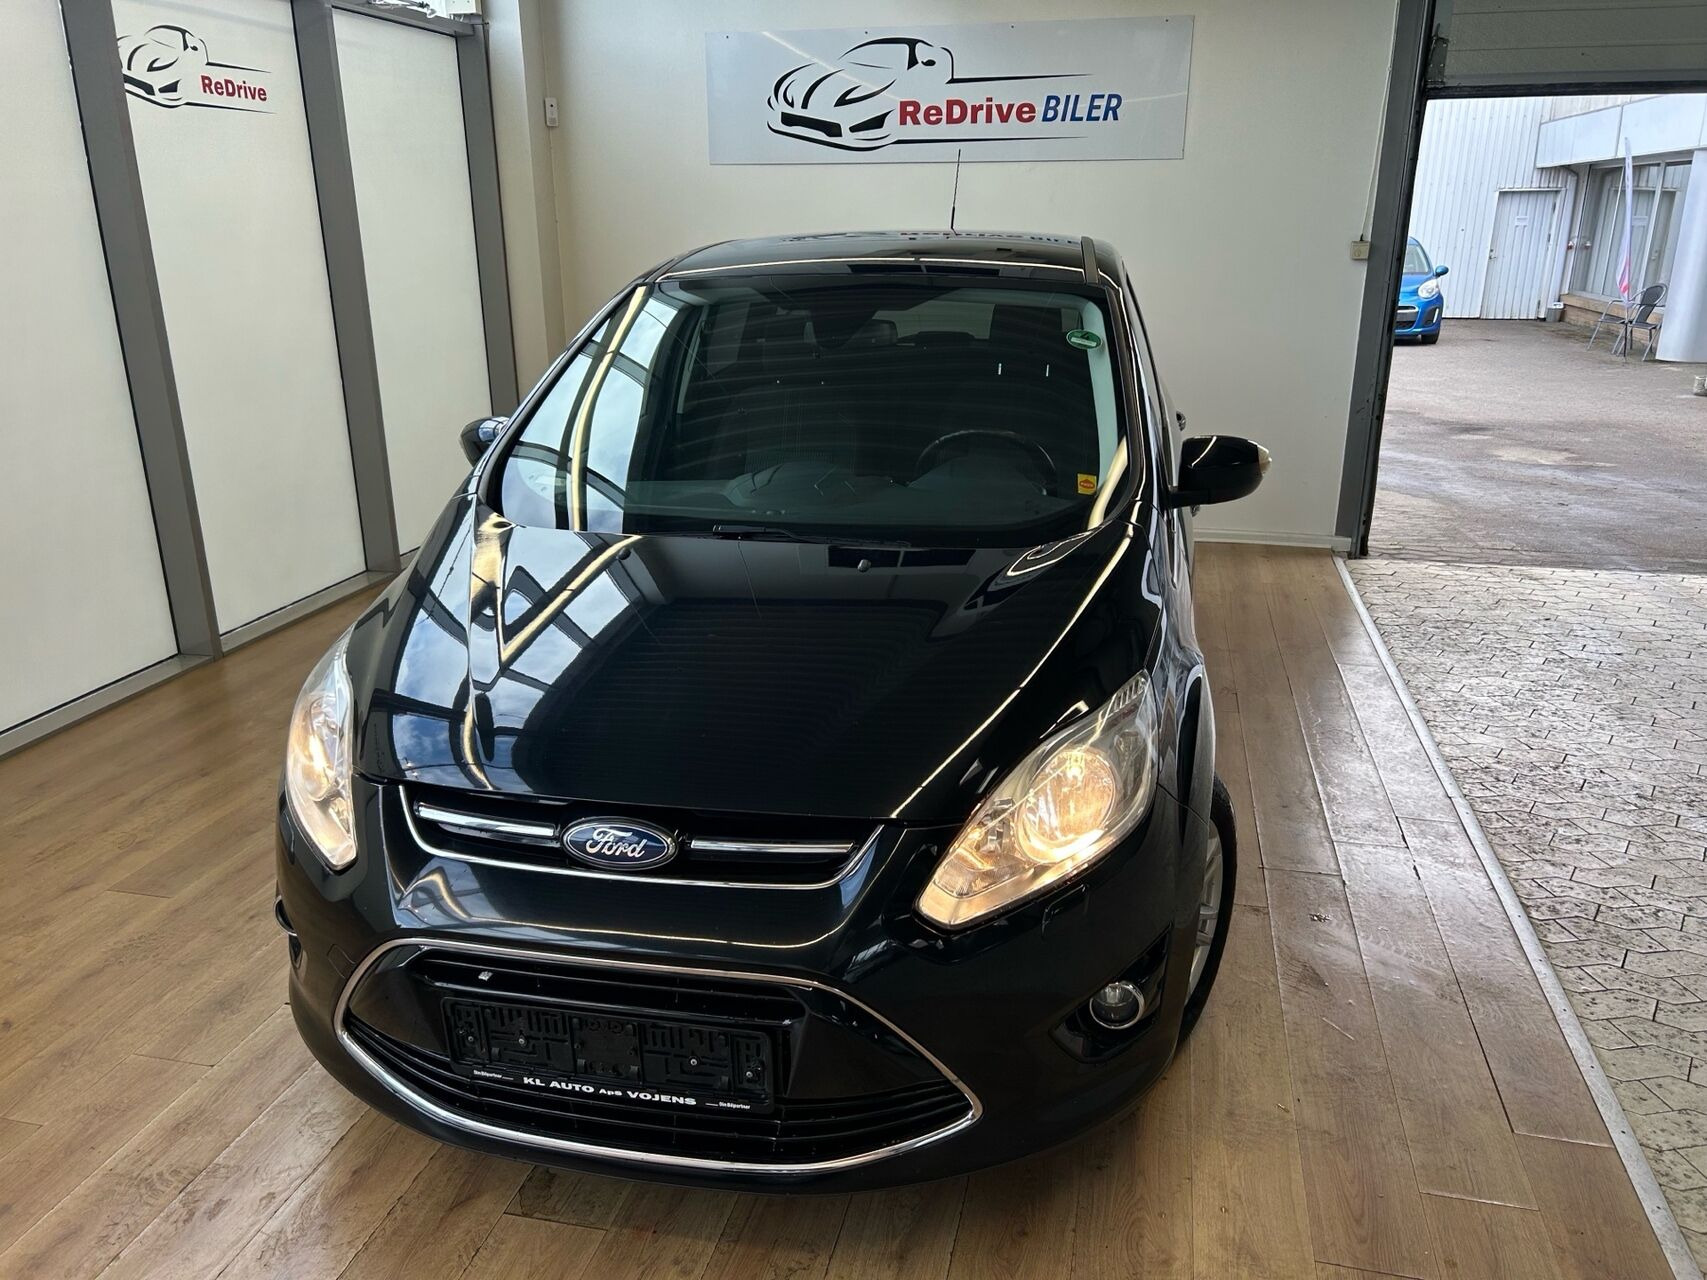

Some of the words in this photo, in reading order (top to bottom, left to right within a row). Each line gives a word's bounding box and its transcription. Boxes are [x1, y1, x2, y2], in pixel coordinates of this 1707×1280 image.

[200, 74, 268, 102] ReDrive
[899, 97, 1037, 126] ReDrive
[1041, 93, 1123, 123] BILER
[585, 827, 647, 858] Ford
[523, 1076, 546, 1086] KL
[549, 1081, 595, 1093] AUTO
[599, 1088, 623, 1096] ApS
[627, 1090, 697, 1106] VOJENS
